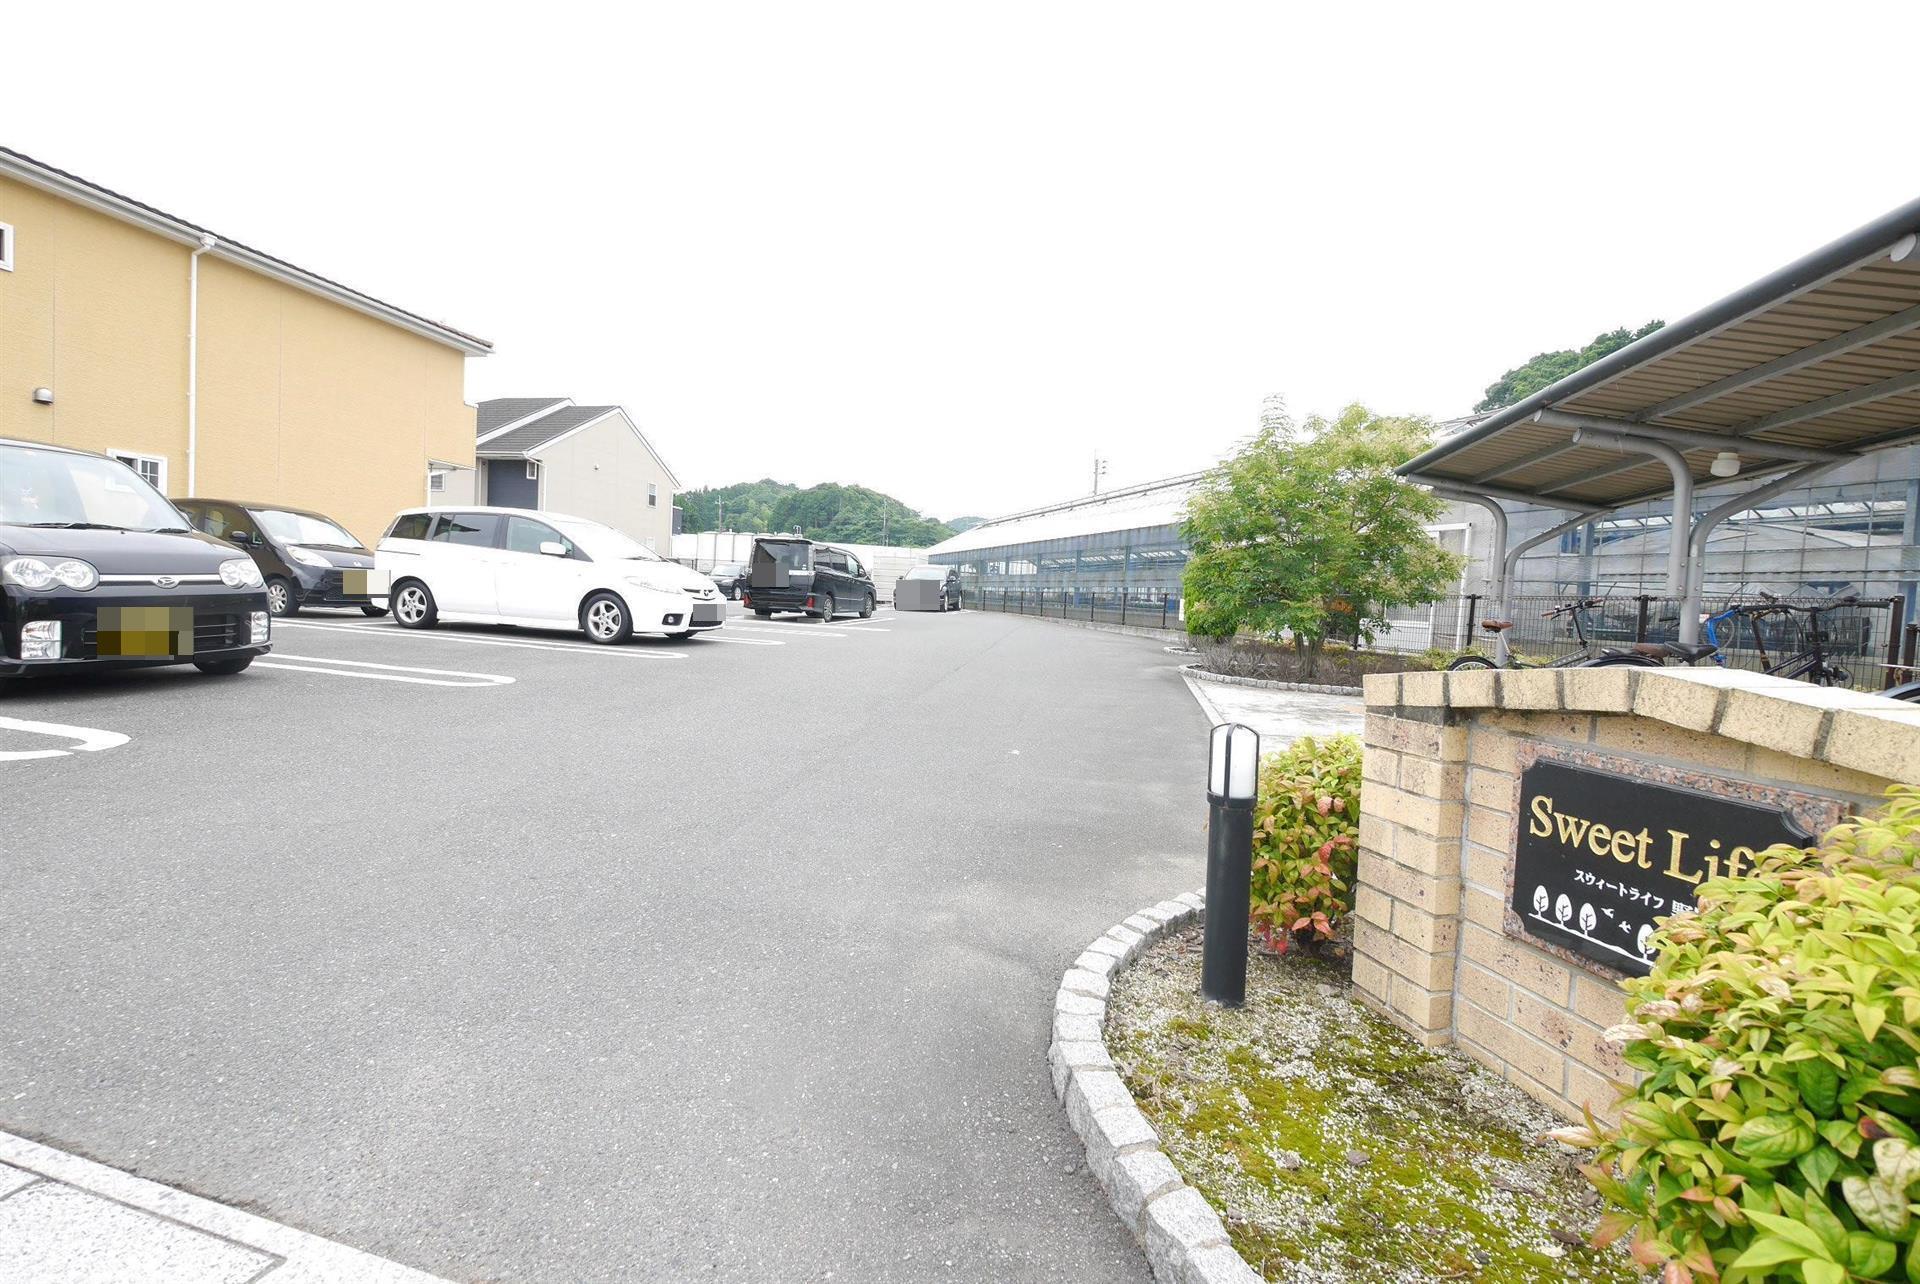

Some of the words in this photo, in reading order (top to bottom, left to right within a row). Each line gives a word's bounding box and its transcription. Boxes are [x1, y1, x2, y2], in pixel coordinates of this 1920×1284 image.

[1529, 795, 1653, 868] Sweet
[1663, 829, 1761, 884] Lif
[1573, 869, 1665, 909] スウィートライフ
